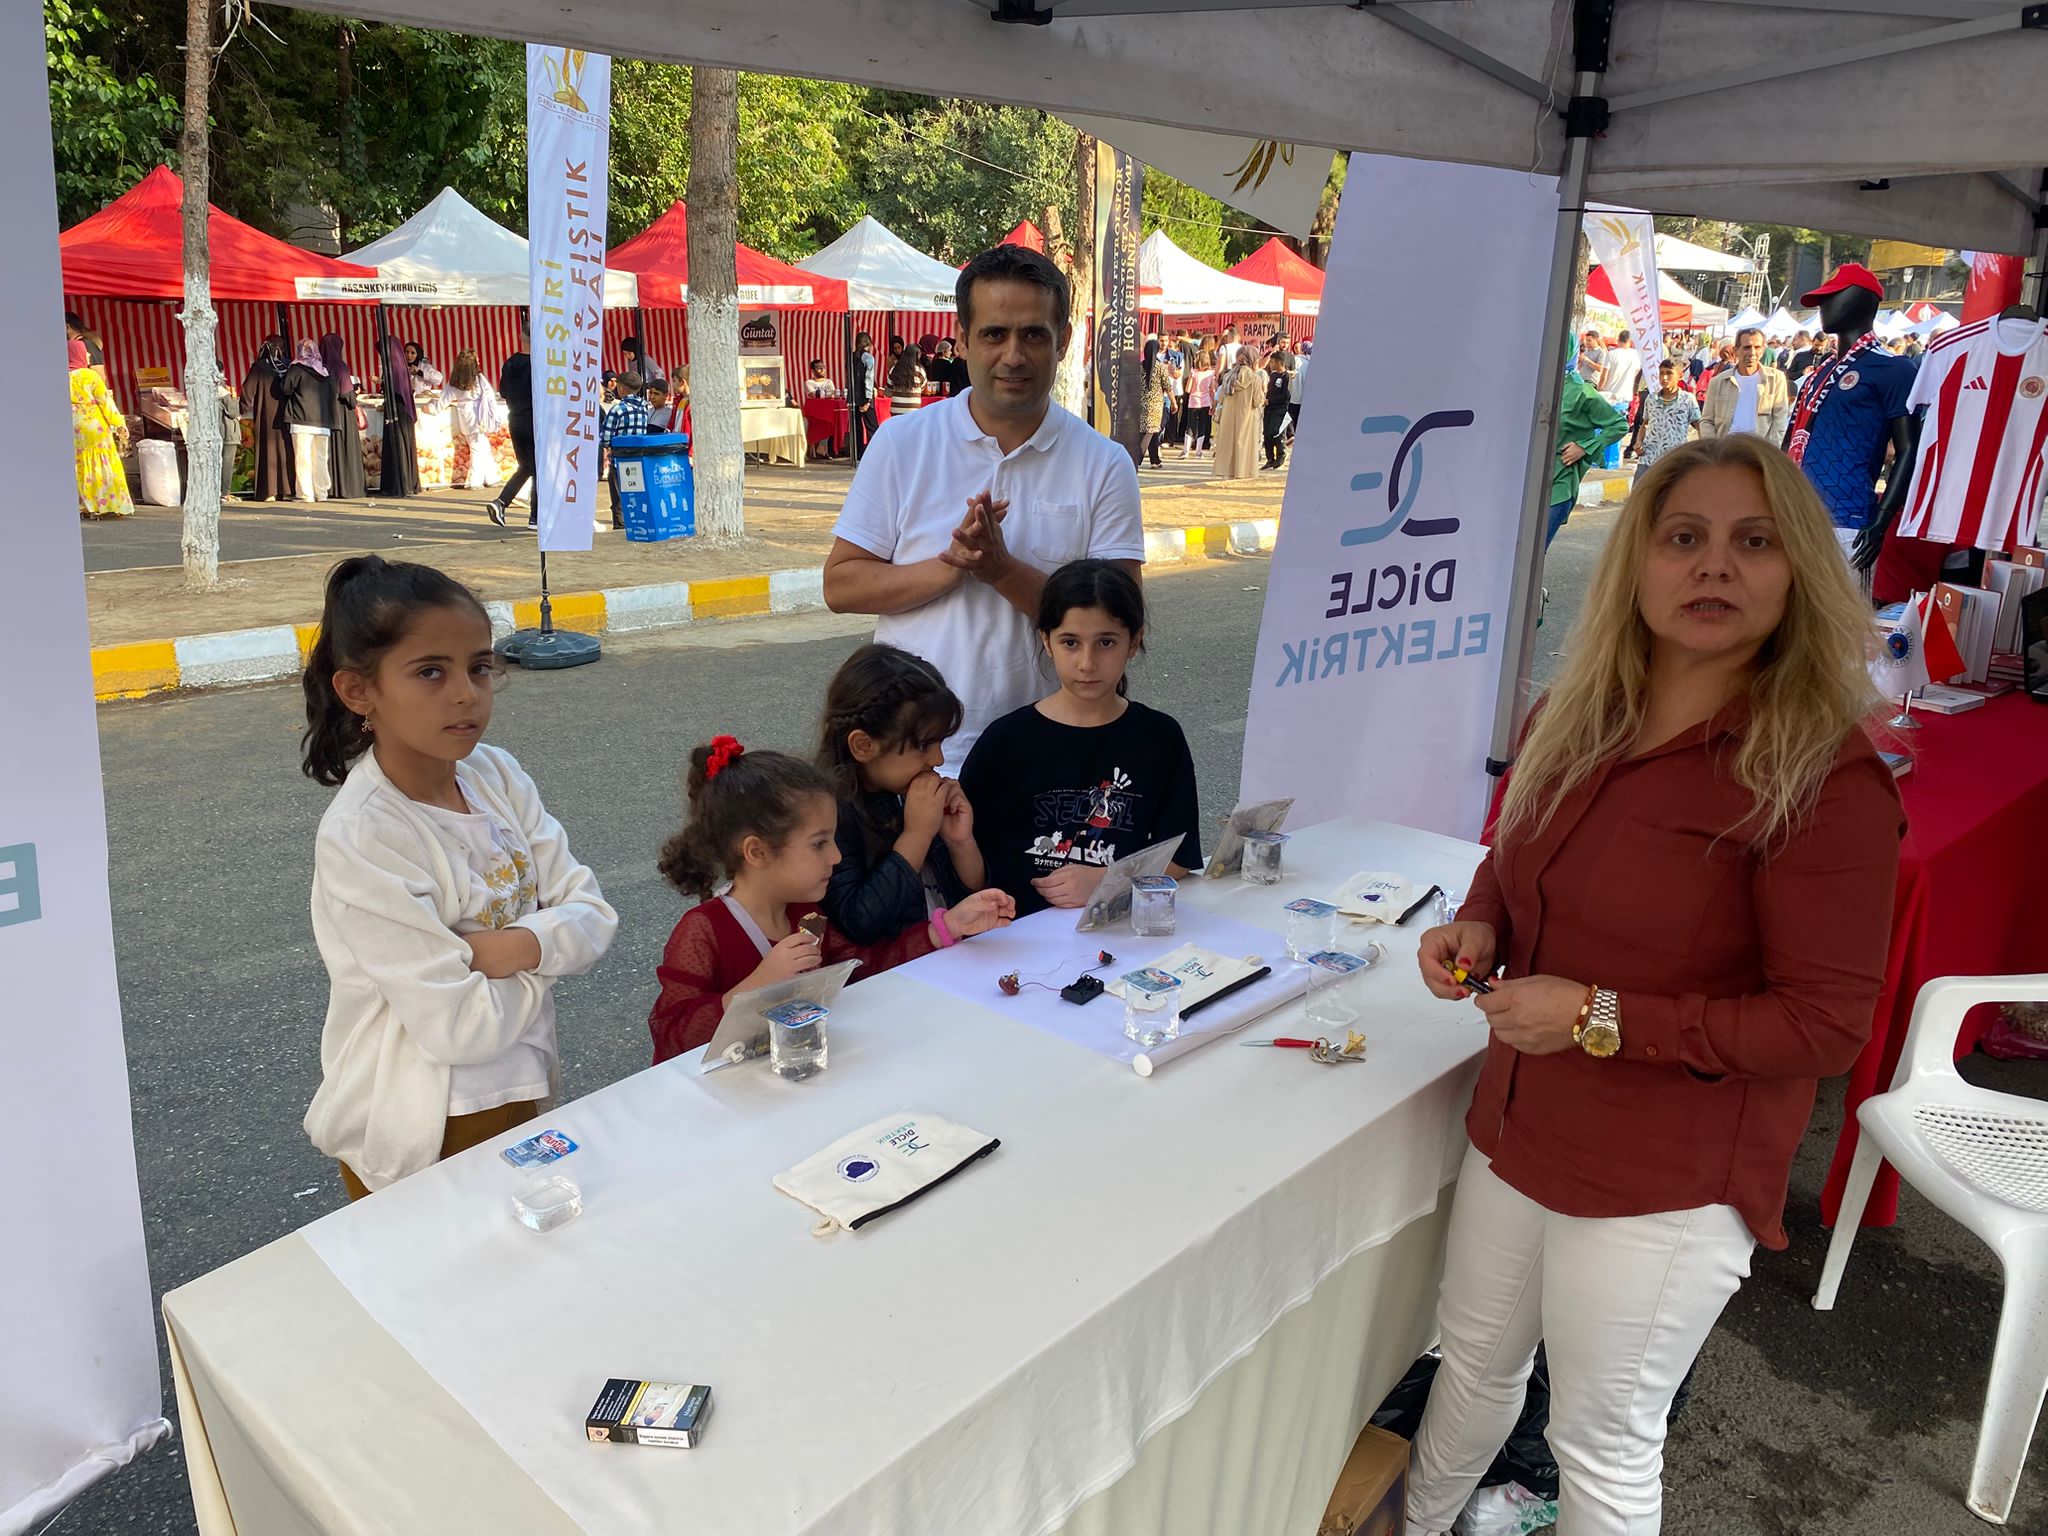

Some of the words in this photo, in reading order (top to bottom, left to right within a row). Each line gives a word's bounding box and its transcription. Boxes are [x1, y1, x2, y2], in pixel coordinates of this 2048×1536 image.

[566, 158, 589, 287] FISTIK
[1124, 231, 1137, 311] GELDİNİZ
[539, 258, 570, 396] BEŞİRİ
[574, 308, 584, 331] &
[583, 231, 603, 441] FESTİVALİ
[1123, 316, 1137, 352] HOŞ
[1243, 323, 1277, 337] PAPATYA
[565, 350, 582, 503] DANUK
